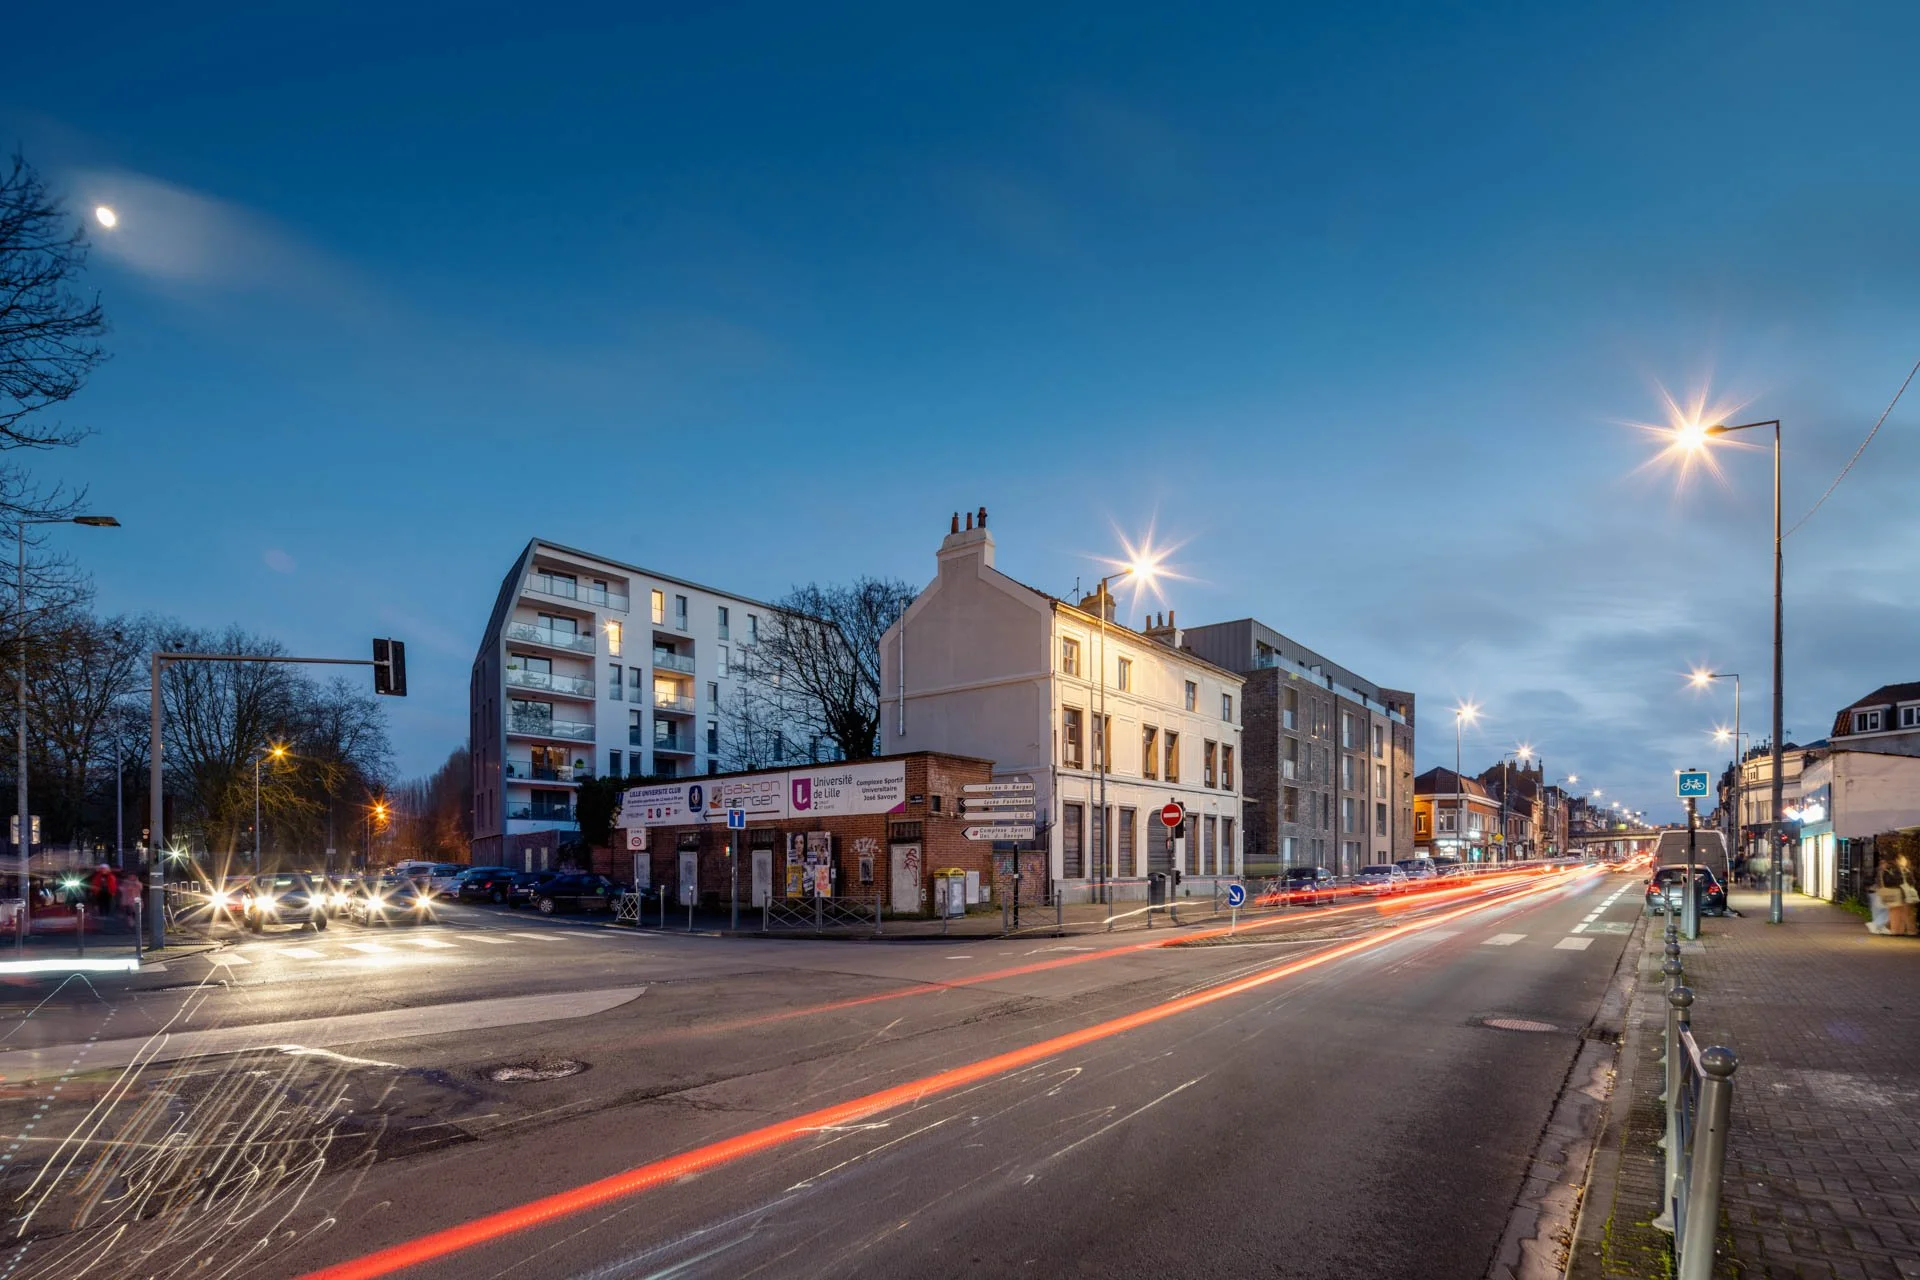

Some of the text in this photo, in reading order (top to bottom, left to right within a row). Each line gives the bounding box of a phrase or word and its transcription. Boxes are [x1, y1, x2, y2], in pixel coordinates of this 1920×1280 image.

[813, 774, 853, 787] Université
[856, 777, 904, 787] Complexe Sportif
[814, 789, 840, 798] de Lille
[814, 801, 818, 809] 2
